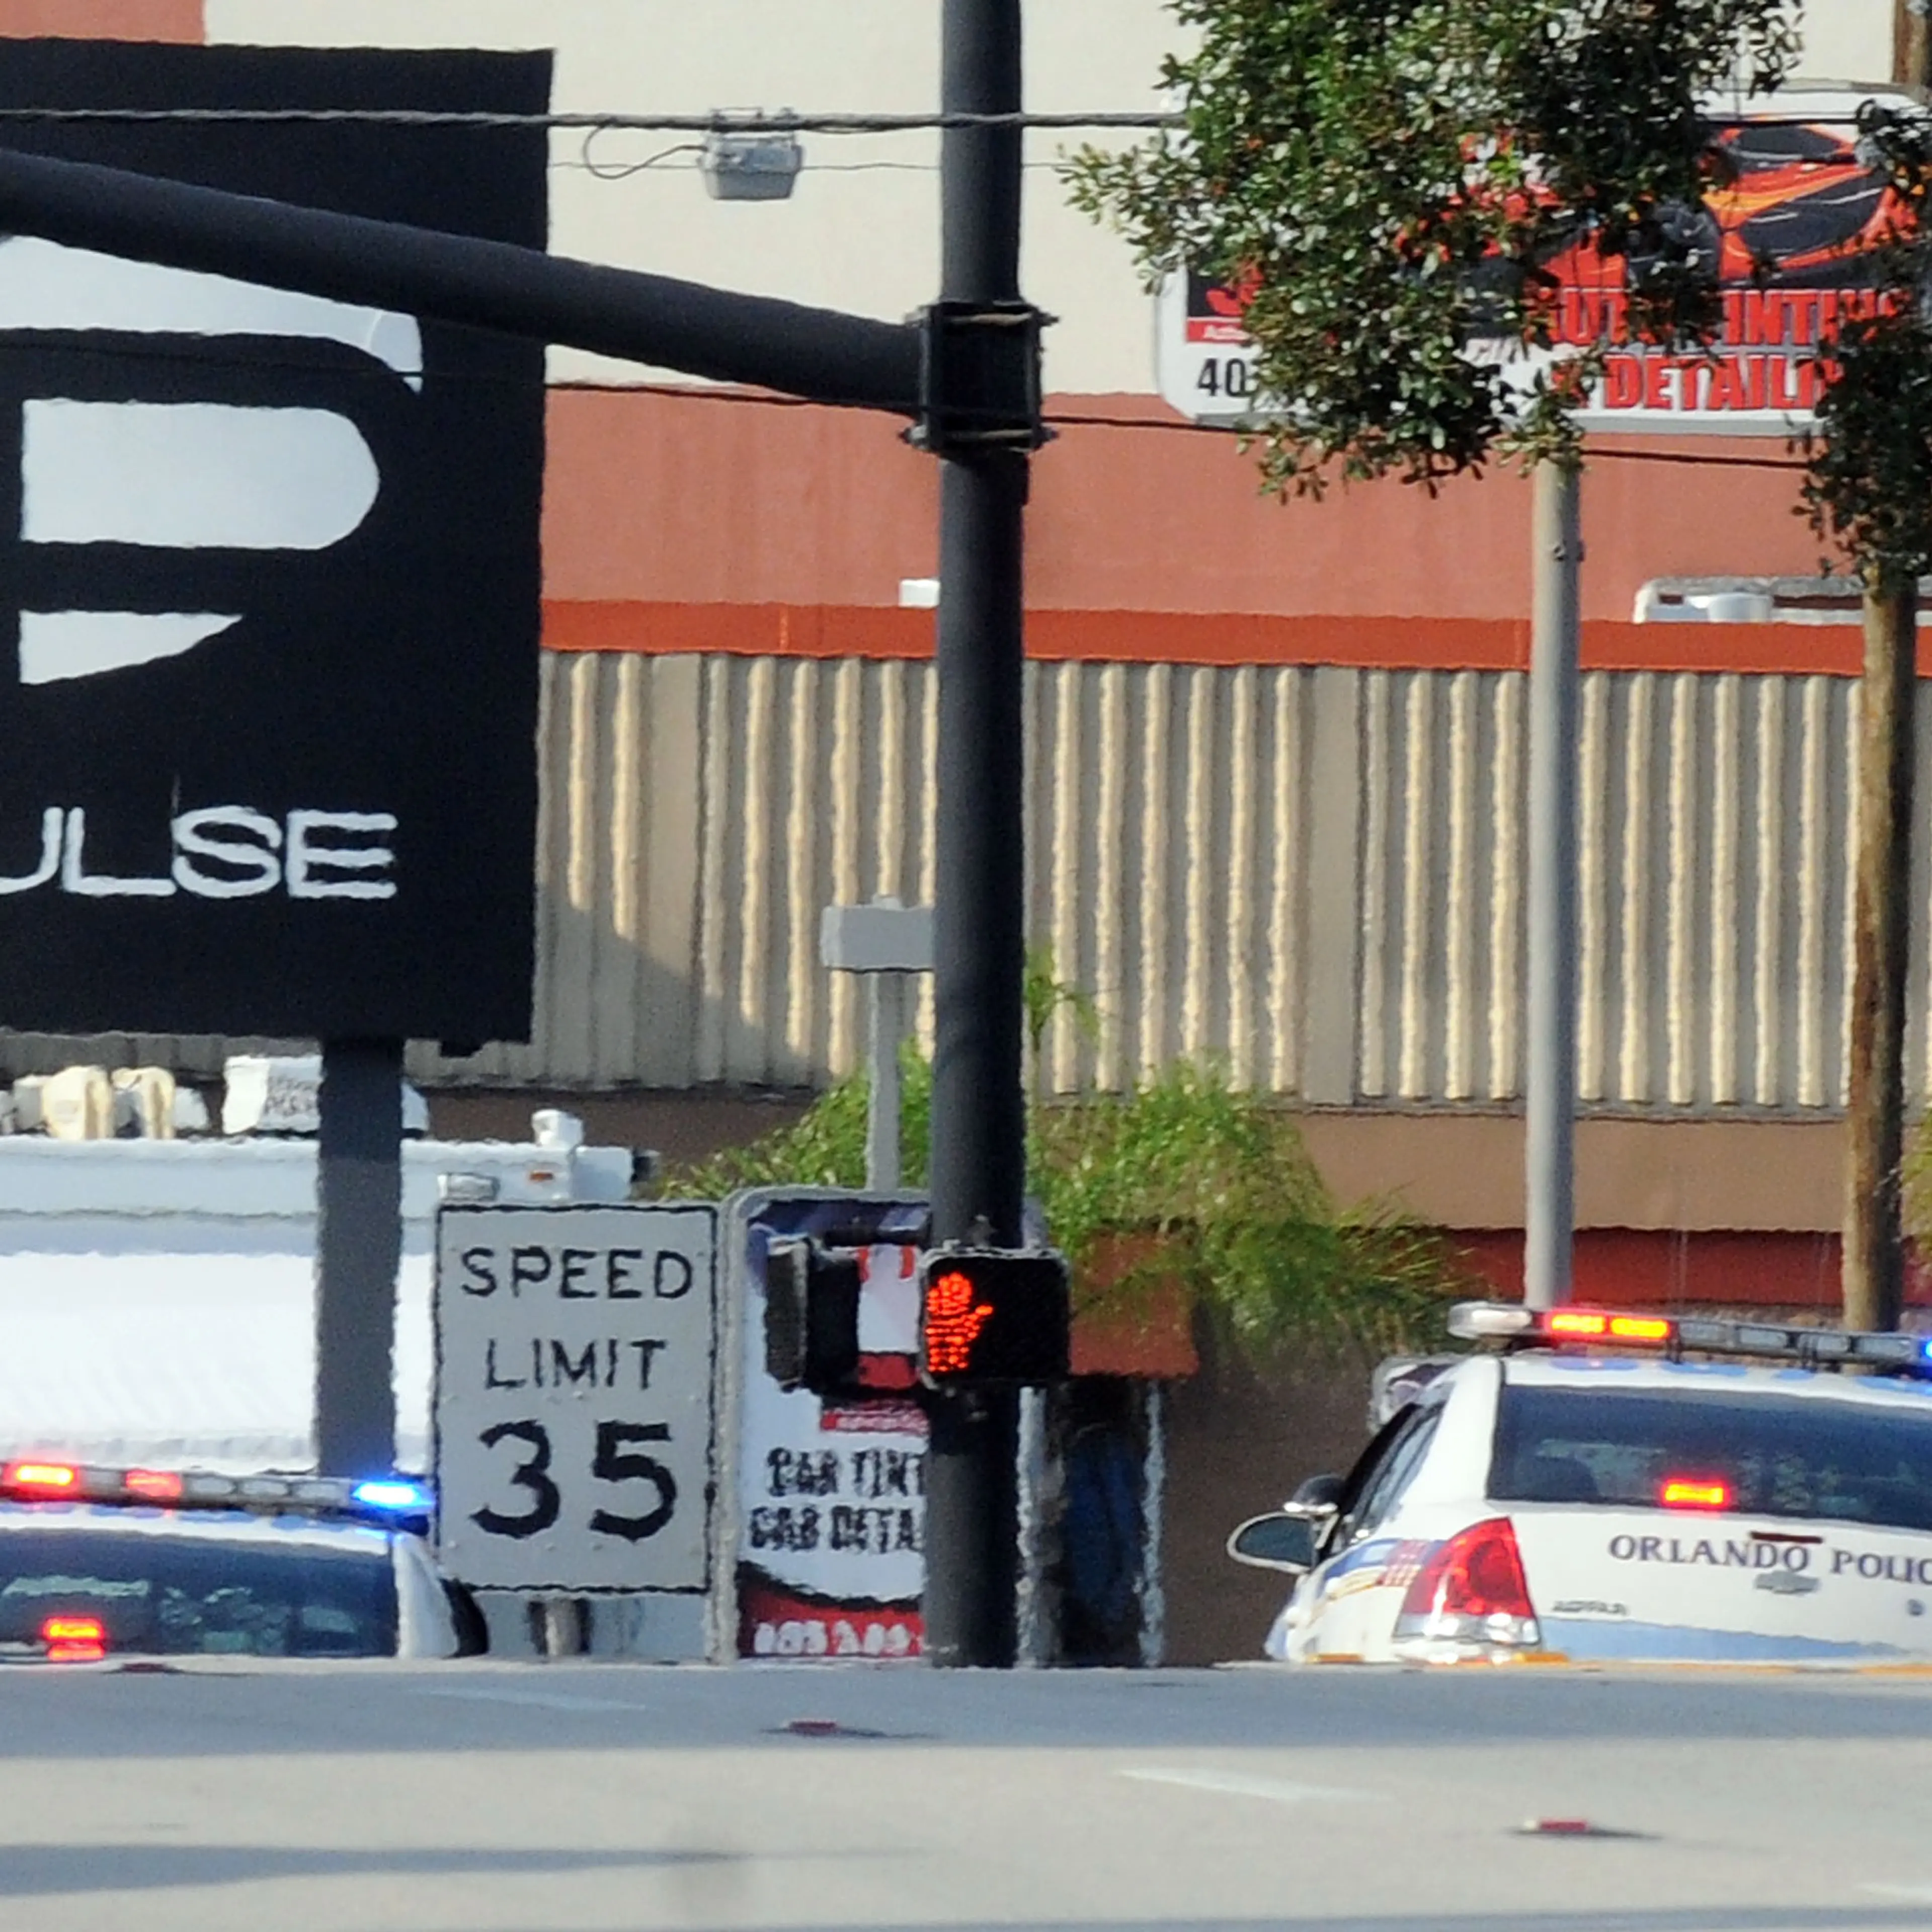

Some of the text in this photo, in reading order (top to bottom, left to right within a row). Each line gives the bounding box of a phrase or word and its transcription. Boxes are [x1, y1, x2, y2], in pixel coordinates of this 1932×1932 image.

[1196, 357, 1248, 397] 40
[461, 1245, 693, 1300] SPEED
[485, 1338, 668, 1390] LIMIT
[468, 1418, 679, 1544] 35
[1609, 1534, 1809, 1572] ORLANDO
